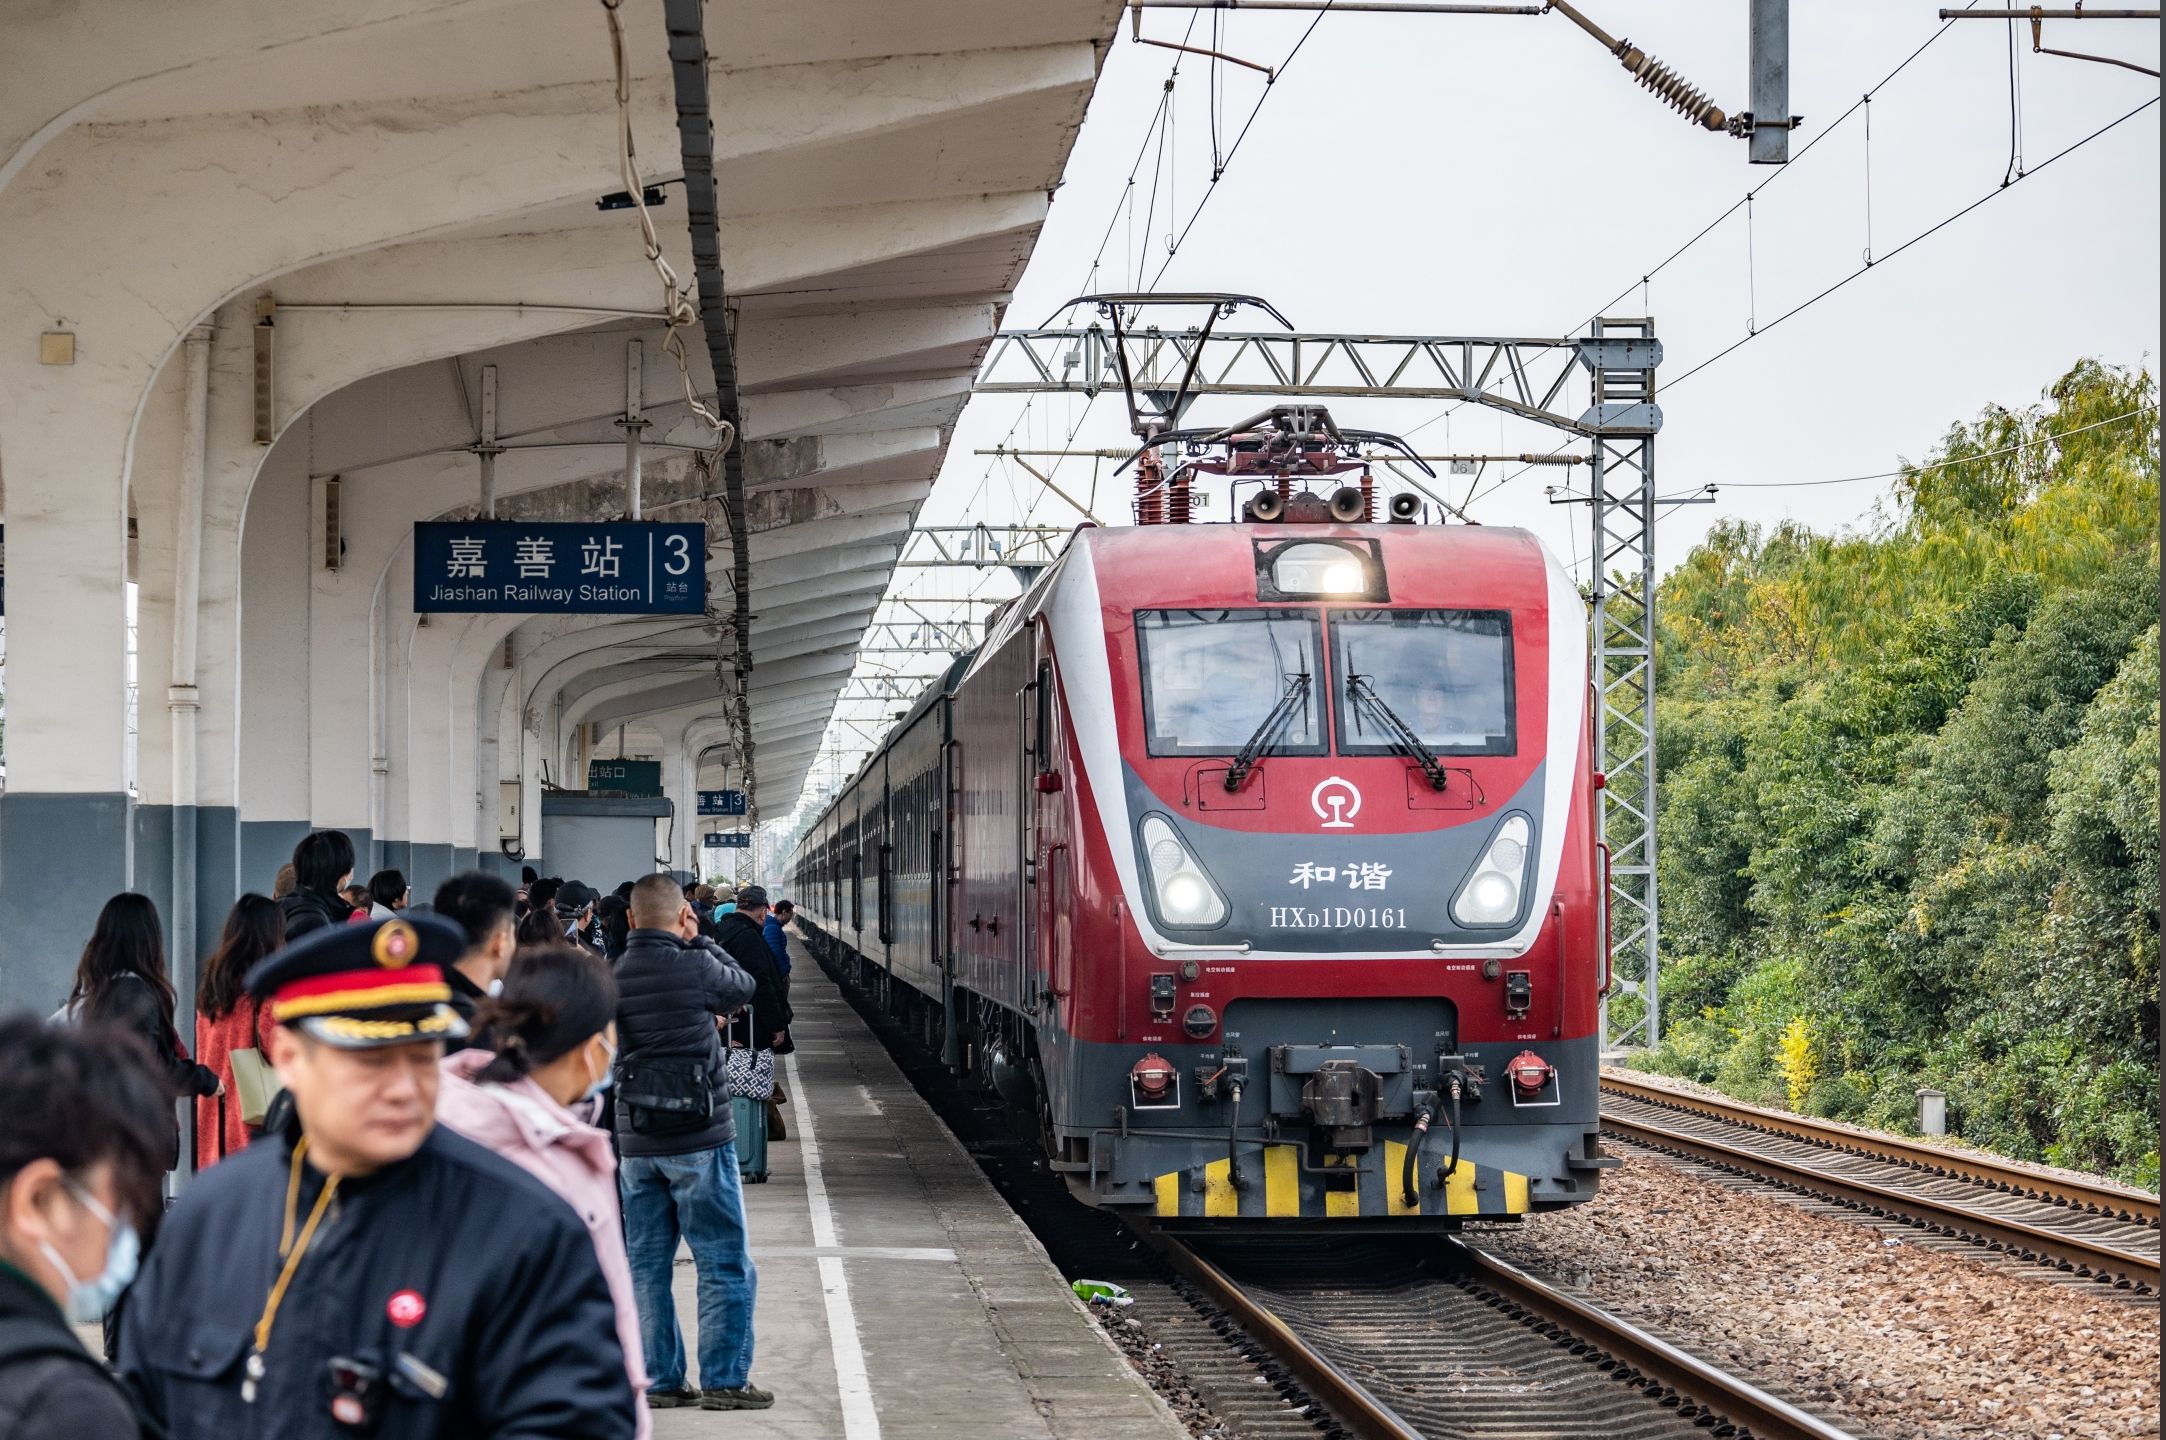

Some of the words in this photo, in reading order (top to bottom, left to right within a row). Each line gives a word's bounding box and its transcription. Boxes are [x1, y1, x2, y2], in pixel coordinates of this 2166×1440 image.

[446, 535, 623, 579] 嘉善站
[664, 534, 691, 575] 3
[429, 584, 498, 601] Jiashan
[504, 584, 573, 605] Railway
[579, 584, 641, 601] Station
[733, 793, 743, 806] 3
[1288, 861, 1393, 890] 和谐
[1270, 907, 1407, 929] HXD1D0161
